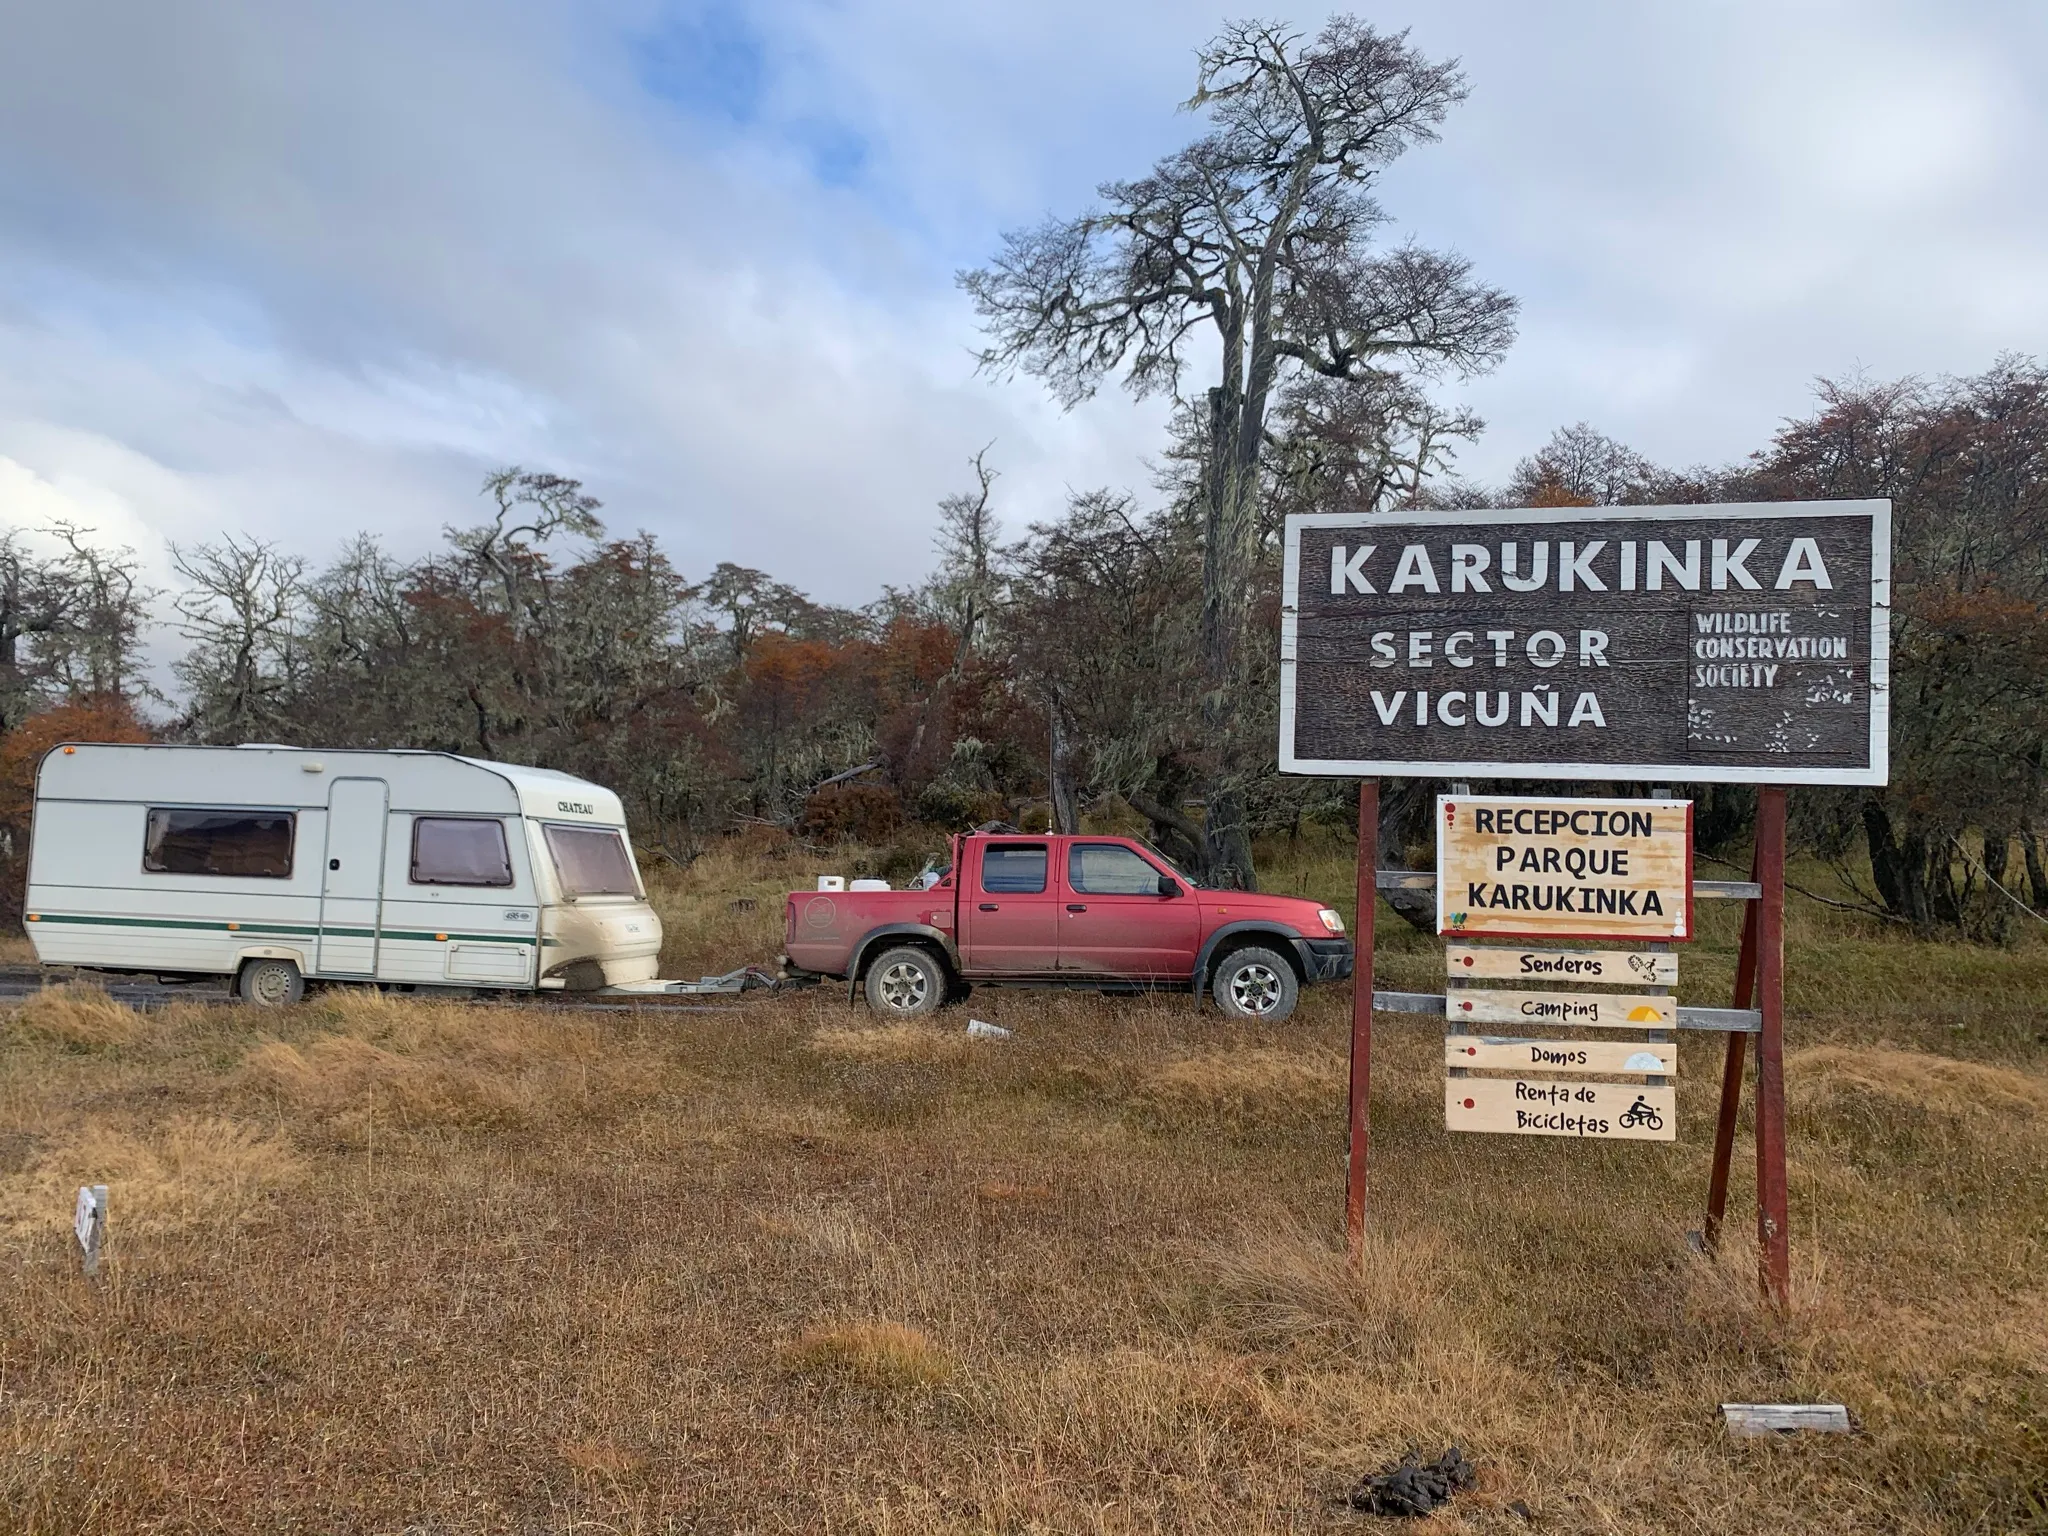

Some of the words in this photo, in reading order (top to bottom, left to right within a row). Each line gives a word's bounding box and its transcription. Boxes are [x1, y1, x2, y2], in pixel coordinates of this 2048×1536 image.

[1329, 536, 1834, 595] KARUKINKA
[1696, 612, 1791, 634] WILDLIFE
[1369, 629, 1610, 668] SECTOR
[1695, 636, 1848, 659] CONSERVATION
[1695, 663, 1778, 688] SOCIETY
[1369, 684, 1606, 727] VICUÑA
[557, 801, 594, 815] CHATEAU
[1475, 808, 1653, 837] RECEPCION
[1496, 846, 1629, 879] PARQUE
[1468, 882, 1664, 916] KARUKINKA
[1520, 954, 1603, 975] Senderos
[1521, 1001, 1598, 1021] Camping
[1531, 1047, 1587, 1064] Domos
[1515, 1081, 1570, 1103] Renta
[1575, 1086, 1596, 1103] de
[1516, 1110, 1610, 1136] Bicicletas
